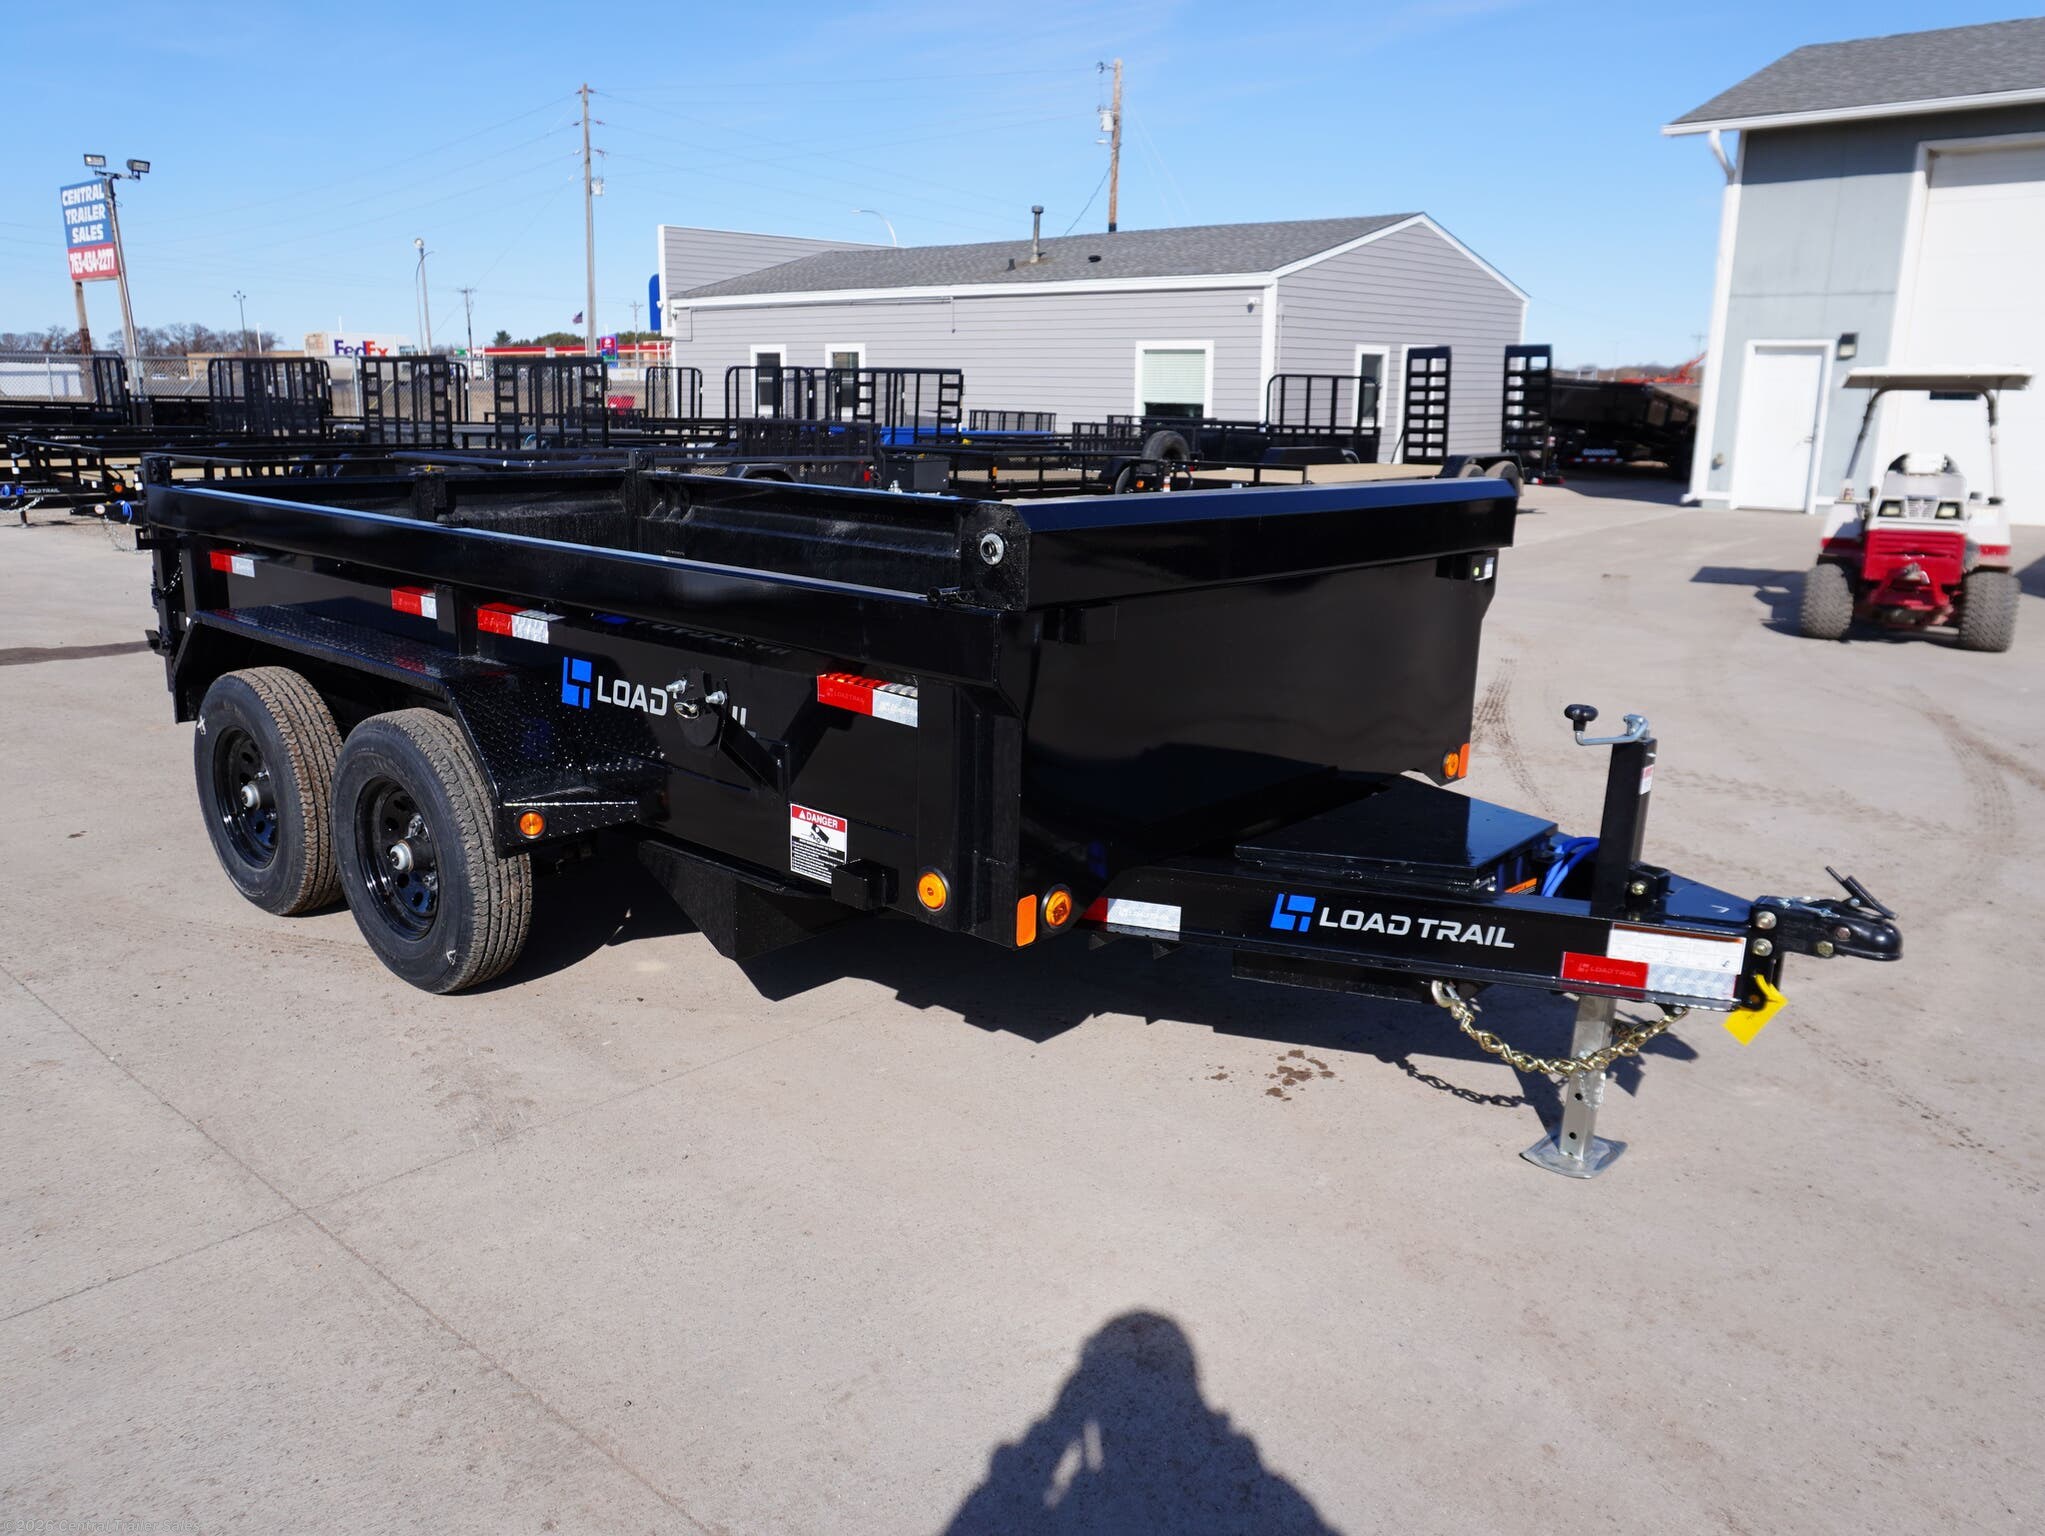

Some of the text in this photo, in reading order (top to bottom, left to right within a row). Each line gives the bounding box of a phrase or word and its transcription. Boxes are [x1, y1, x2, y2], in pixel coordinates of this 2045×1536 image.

[62, 184, 105, 206] CENTRAL
[65, 203, 106, 225] TRAILER
[72, 223, 104, 244] SALES
[333, 339, 388, 356] FedEx
[597, 674, 668, 717] LOAD
[806, 812, 838, 829] DANGER
[1319, 907, 1515, 949] LOAD TRAIL
